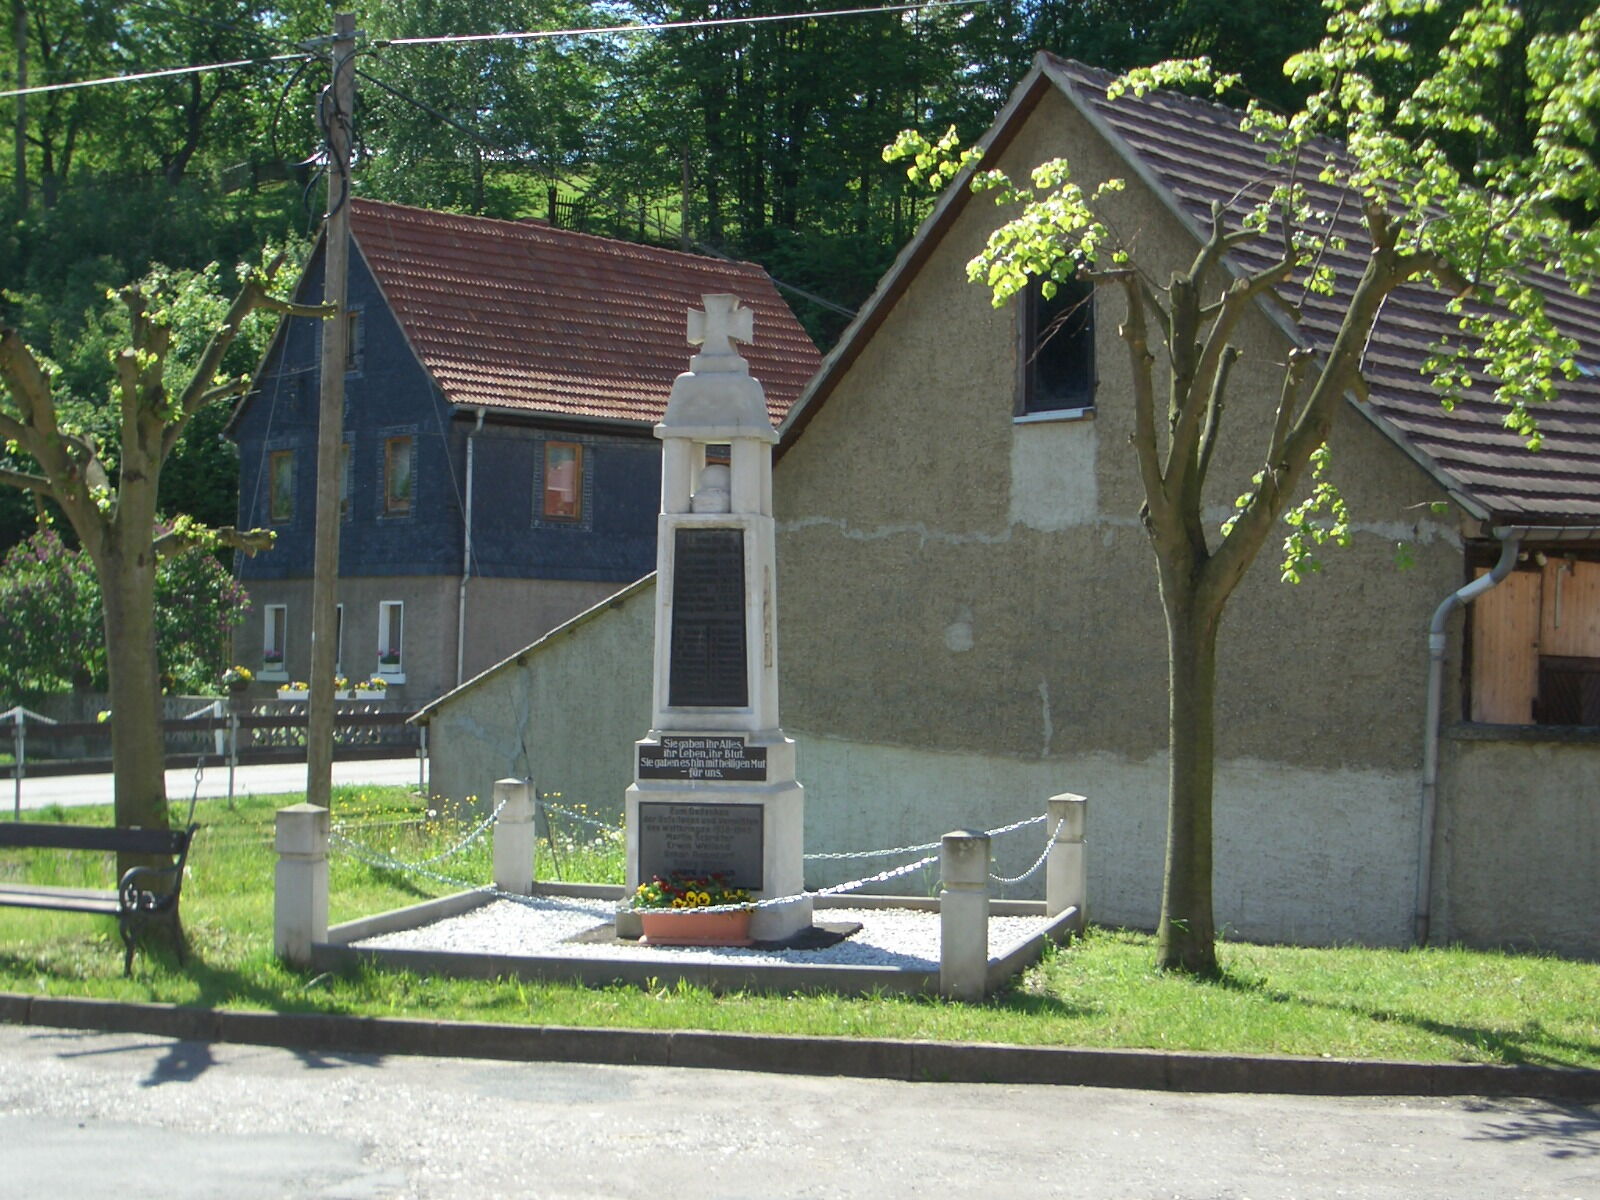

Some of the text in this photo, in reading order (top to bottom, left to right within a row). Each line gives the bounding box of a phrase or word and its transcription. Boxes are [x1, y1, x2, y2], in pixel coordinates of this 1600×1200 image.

[664, 739, 677, 749] Sie
[678, 739, 704, 750] gaben
[719, 740, 743, 750] Alles,
[679, 749, 708, 758] Leben,
[641, 757, 653, 767] Sie
[654, 758, 679, 768] gaben
[691, 759, 704, 767] hin
[705, 759, 718, 768] mit
[689, 769, 701, 778] für
[705, 769, 723, 777] uns.
